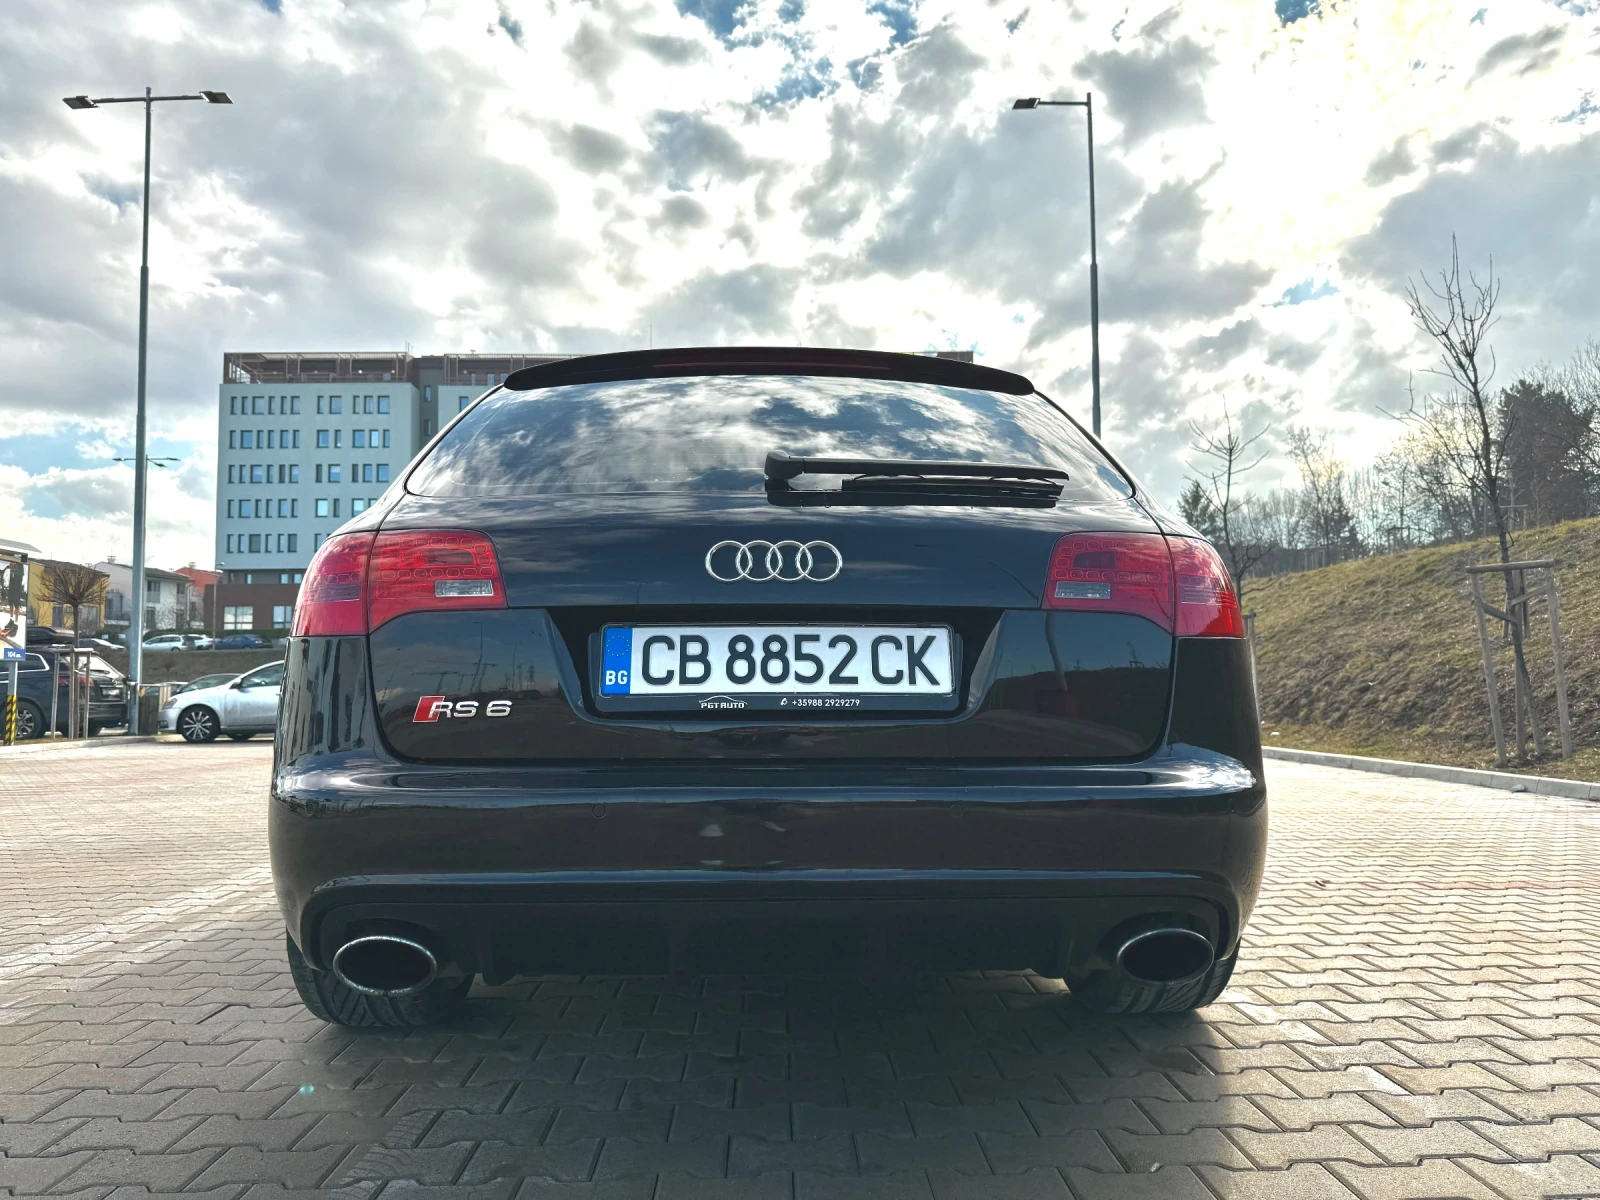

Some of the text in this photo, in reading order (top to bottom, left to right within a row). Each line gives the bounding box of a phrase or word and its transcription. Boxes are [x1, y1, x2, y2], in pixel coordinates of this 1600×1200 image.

[641, 634, 941, 686] CB 8852 CK
[605, 670, 628, 685] BG
[791, 698, 860, 707] +35988 2929279
